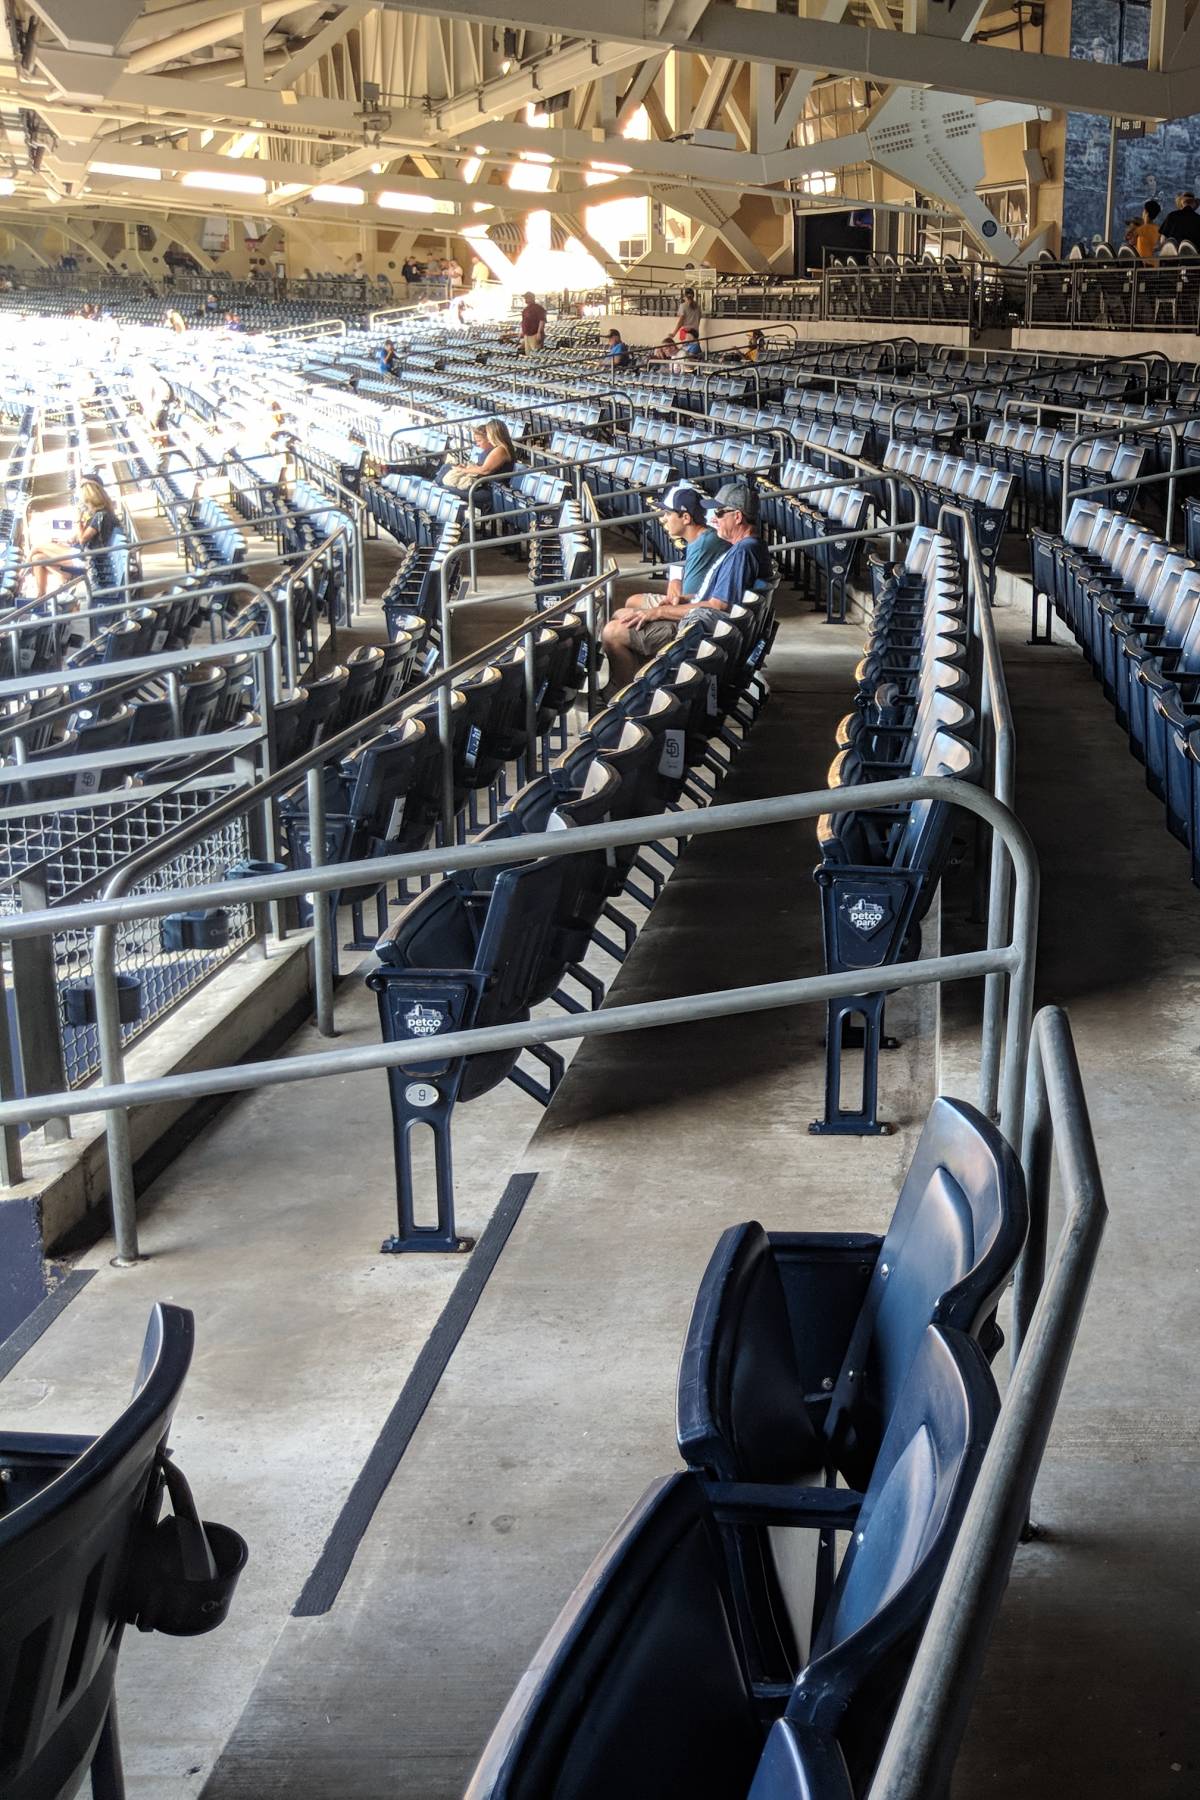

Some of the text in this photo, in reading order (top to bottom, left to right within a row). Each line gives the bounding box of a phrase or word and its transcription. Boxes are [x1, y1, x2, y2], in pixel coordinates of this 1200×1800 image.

[850, 911, 882, 922] petco
[856, 919, 876, 929] park
[407, 1017, 441, 1029] petco
[413, 1024, 436, 1035] park
[418, 1089, 426, 1101] 9
